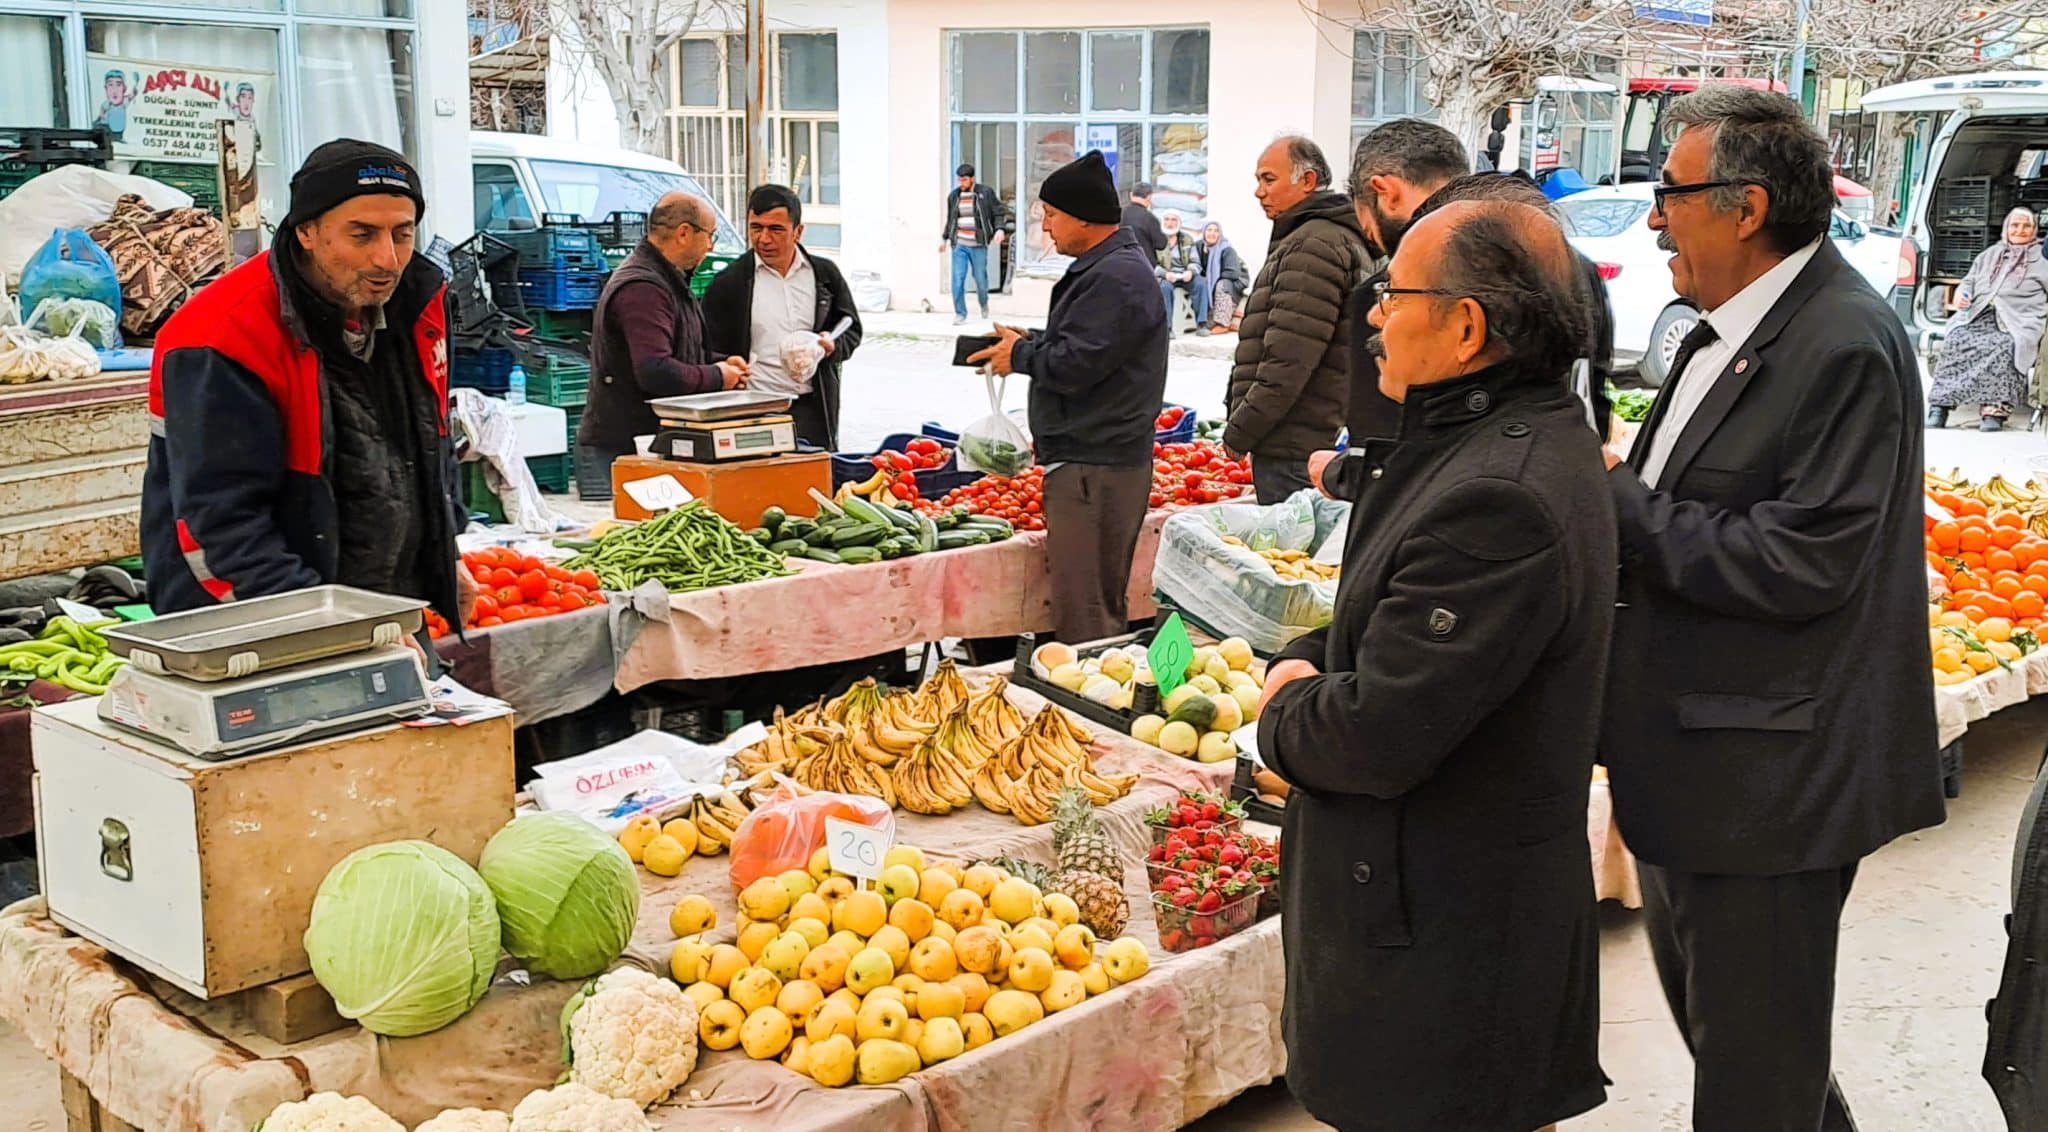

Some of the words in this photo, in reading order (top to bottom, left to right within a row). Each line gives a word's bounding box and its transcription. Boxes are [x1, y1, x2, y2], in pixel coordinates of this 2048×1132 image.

[143, 69, 187, 94] AŞÇI
[144, 95, 176, 105] DÜĞÜN
[184, 99, 218, 109] SÜNNET
[164, 108, 200, 118] MEVLÜT
[133, 116, 196, 129] YEMEKLERİNE
[142, 137, 168, 148] 0537
[172, 140, 190, 149] 484
[194, 142, 206, 151] 48
[1155, 640, 1179, 684] 50
[841, 830, 877, 867] 20
